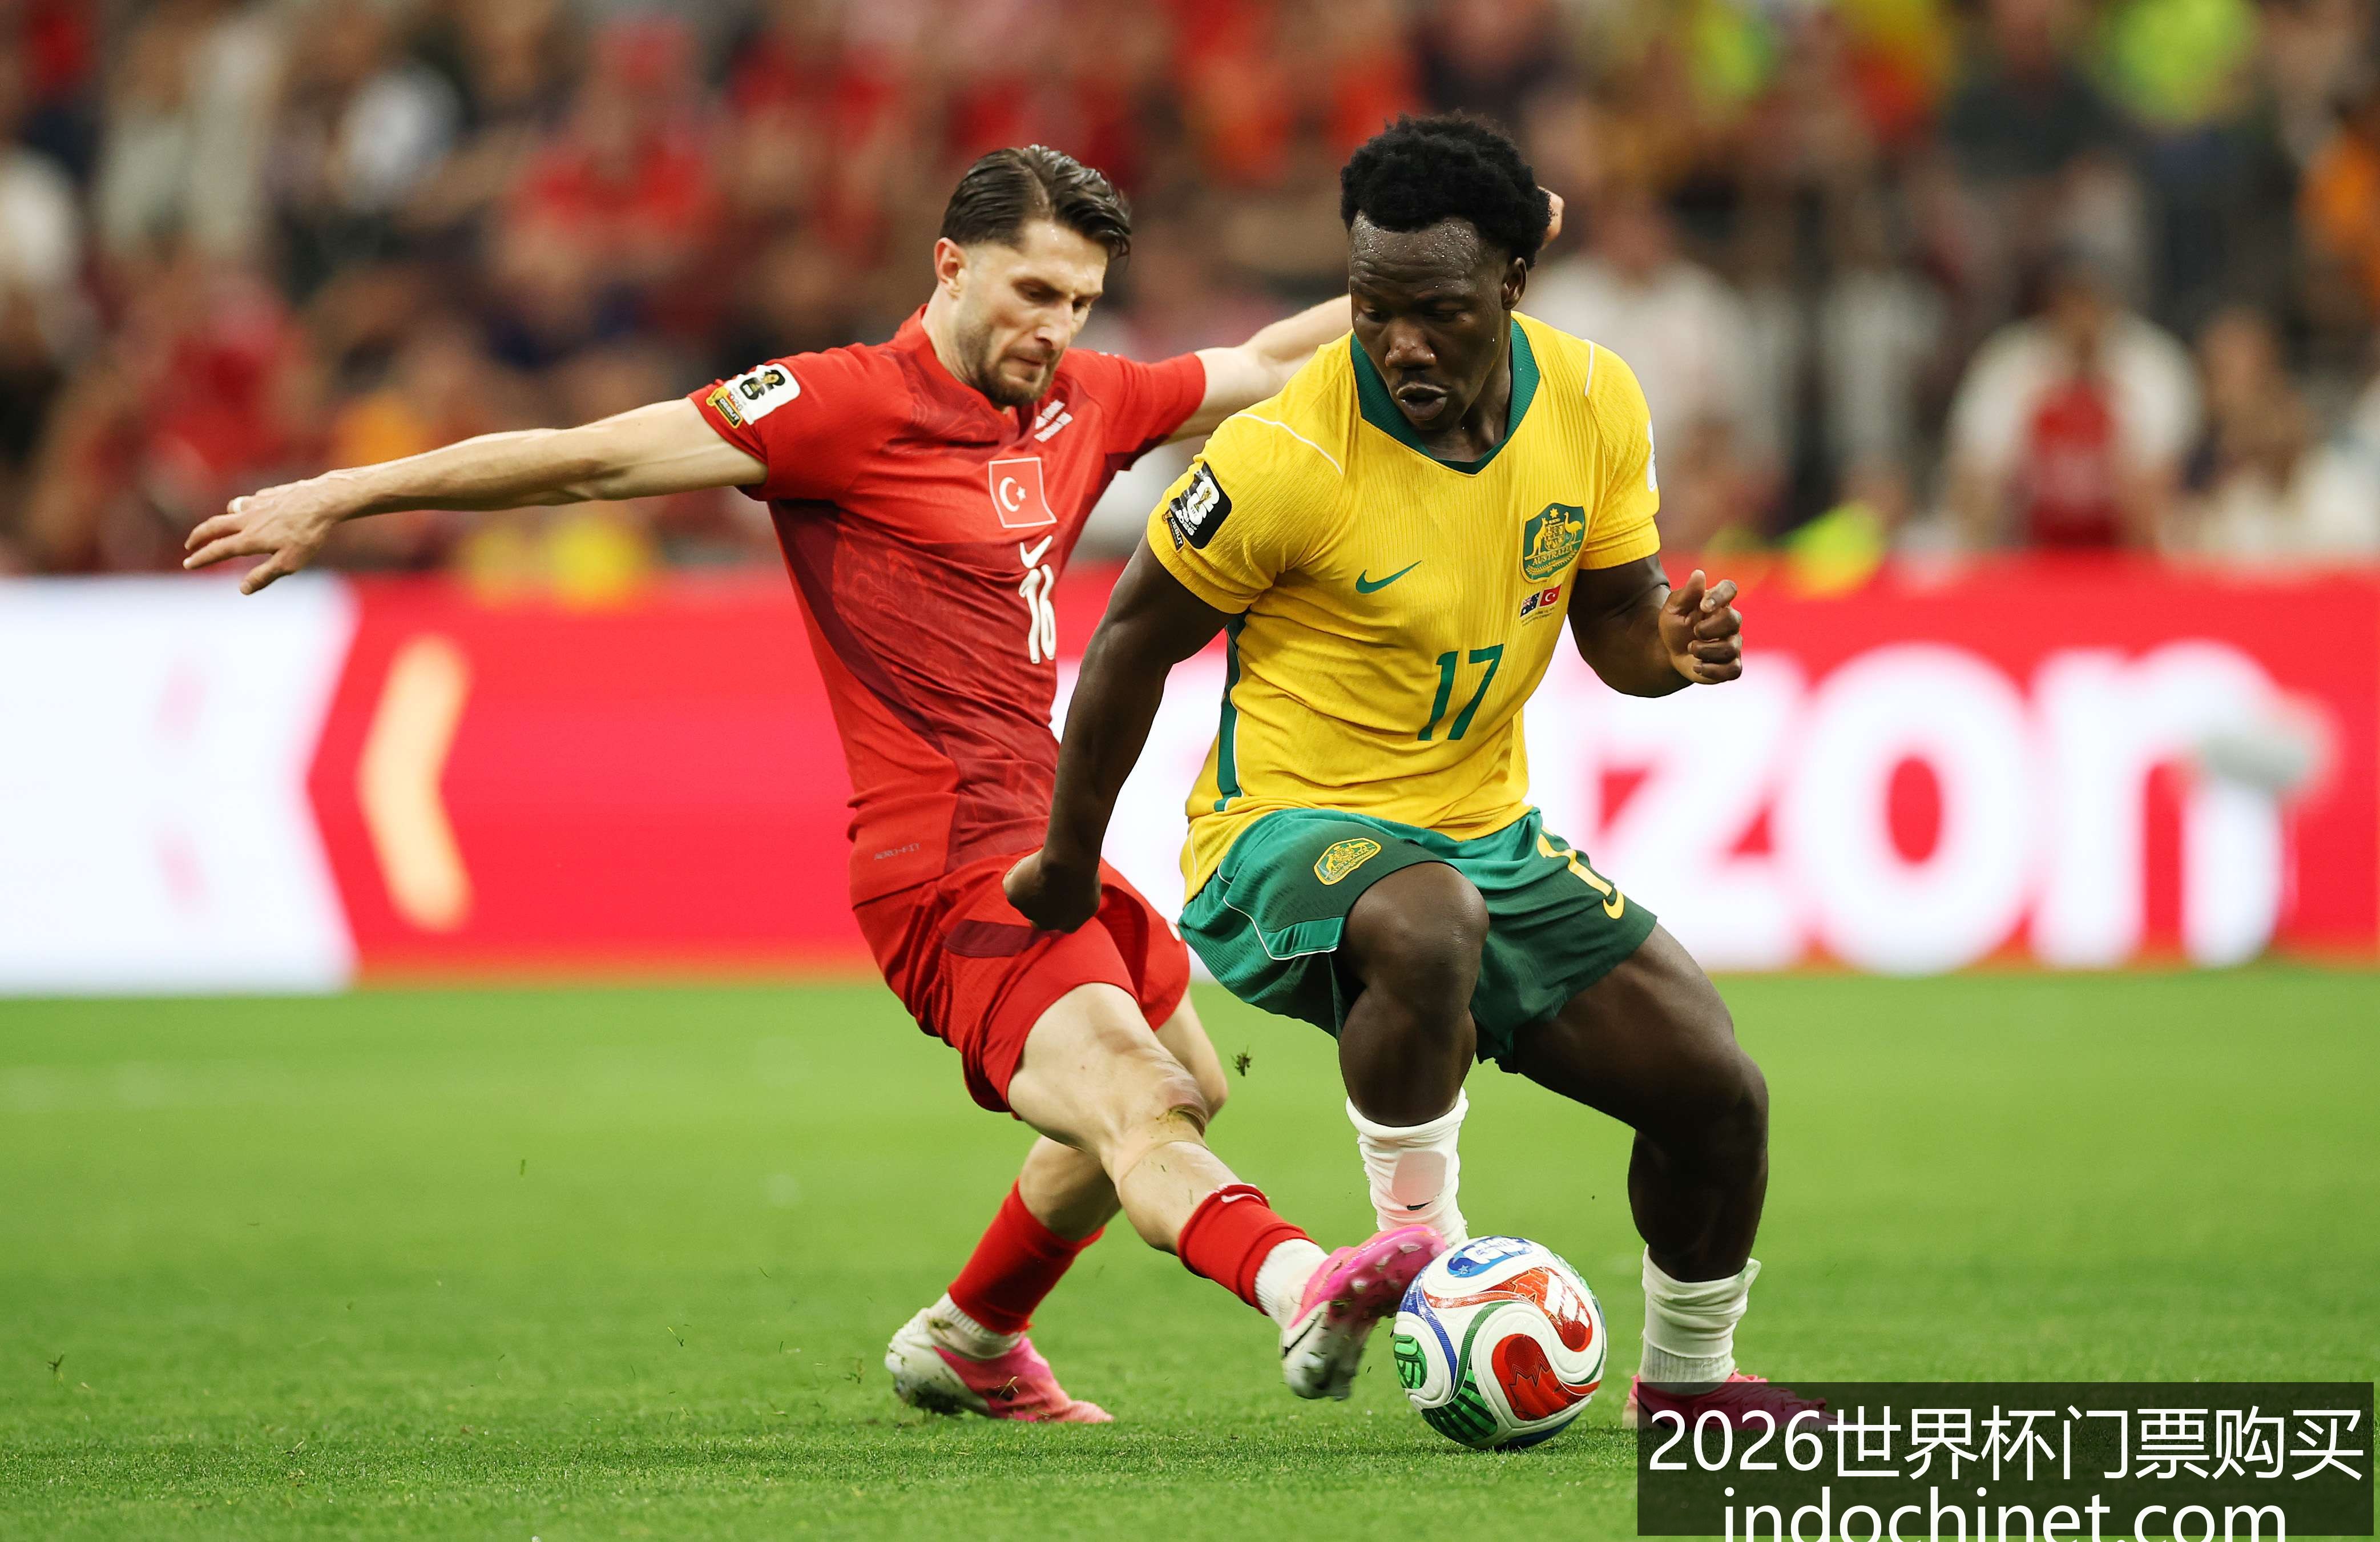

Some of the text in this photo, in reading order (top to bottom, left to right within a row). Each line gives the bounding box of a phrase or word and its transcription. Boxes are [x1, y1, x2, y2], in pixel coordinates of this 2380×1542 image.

[1171, 517, 1183, 544] DEBUT
[1175, 509, 1195, 536] 2026
[1018, 563, 1056, 665] 16
[1417, 643, 1504, 741] 17
